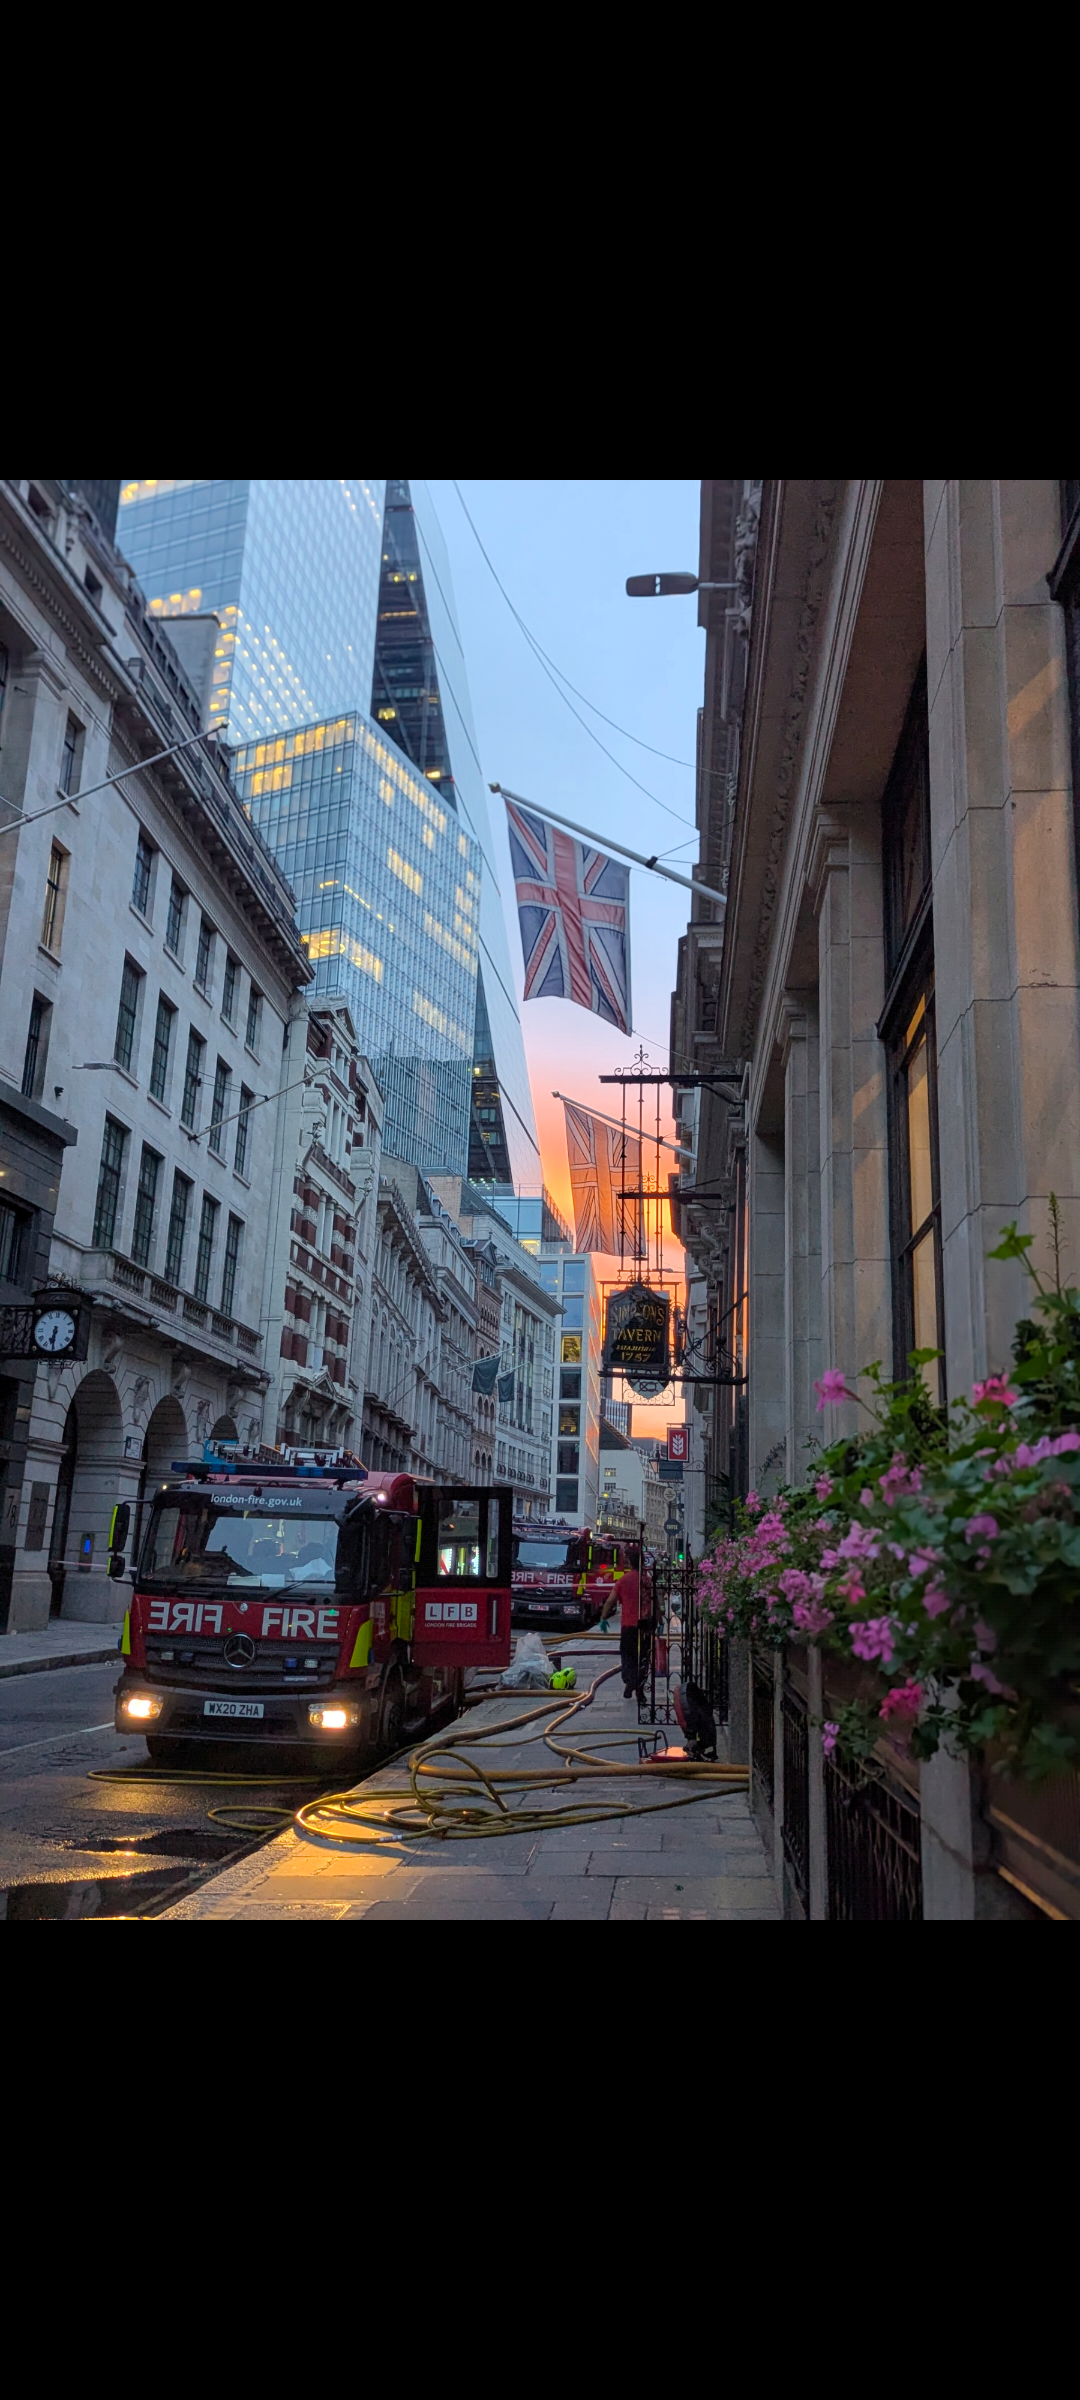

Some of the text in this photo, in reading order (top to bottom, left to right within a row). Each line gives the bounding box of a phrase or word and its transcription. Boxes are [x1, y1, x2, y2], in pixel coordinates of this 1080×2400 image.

[611, 1328, 661, 1342] TAVERN
[210, 1493, 303, 1508] london-fire.gov.uk
[6, 1495, 17, 1528] 78
[546, 1573, 573, 1584] FIRE
[261, 1607, 340, 1639] FIRE
[209, 1702, 259, 1716] WX20 ZHA
